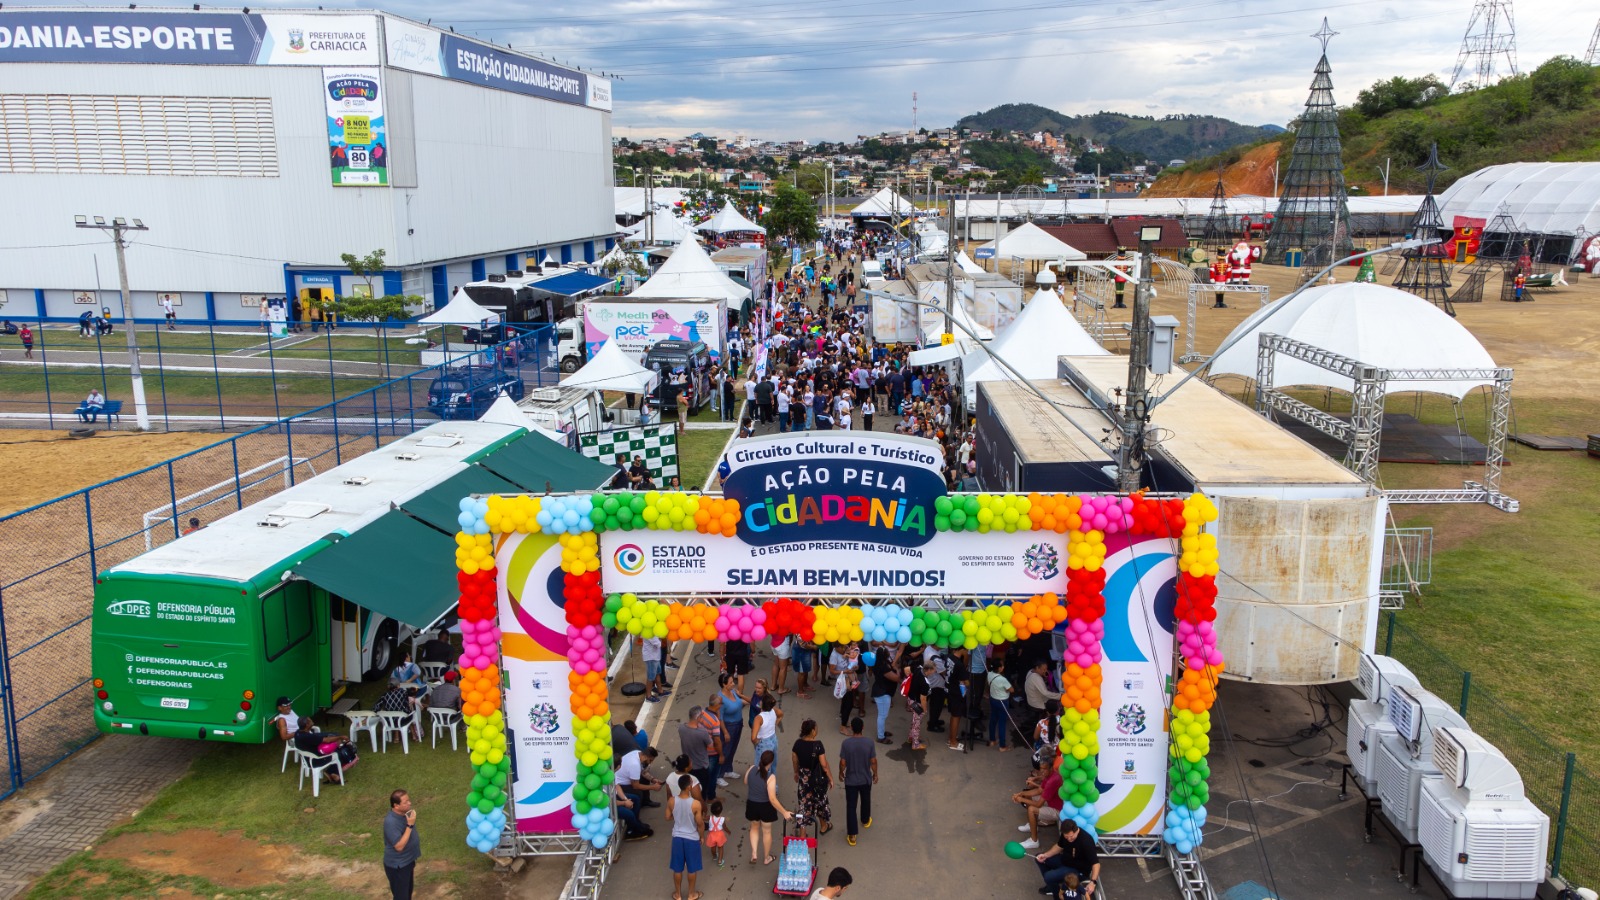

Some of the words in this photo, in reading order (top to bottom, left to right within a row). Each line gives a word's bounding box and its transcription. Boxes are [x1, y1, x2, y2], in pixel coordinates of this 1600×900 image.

[309, 32, 354, 40] PREFEITURA
[355, 32, 366, 40] DE
[310, 41, 367, 51] CARIACICA
[457, 48, 501, 81] ESTAÇÃO
[503, 62, 580, 96] CIDADANIA-ESPORTE
[336, 80, 352, 88] AÇÃO
[354, 80, 369, 88] PELA
[351, 152, 366, 162] 80
[616, 324, 649, 340] pet
[735, 445, 792, 463] Circuito
[796, 441, 854, 455] Cultural
[858, 446, 867, 454] e
[871, 444, 936, 465] Turístico
[765, 465, 831, 492] AÇÃO
[843, 467, 906, 493] PELA
[652, 545, 706, 558] ESTADO
[751, 547, 758, 557] É
[759, 547, 766, 555] O
[768, 543, 806, 554] ESTADO
[808, 542, 859, 550] PRESENTE
[861, 543, 875, 552] NA
[877, 545, 897, 555] SUA
[899, 547, 923, 558] VIDA
[652, 558, 706, 568] PRESENTE
[727, 568, 797, 586] SEJAM
[803, 569, 946, 587] BEM-VINDOS!
[127, 604, 151, 615] DPES
[157, 602, 202, 614] DEFENSORIA
[203, 604, 236, 616] PÚBLICA
[165, 613, 185, 621] ESTADO
[194, 615, 217, 623] ESPÍRITO
[218, 616, 236, 624] SANTO
[135, 655, 228, 669] DEFENSORIAPUBLICA_ES
[136, 667, 224, 680] DEFENSORIAPUBLICAES
[136, 678, 193, 689] DEFENSORIAES
